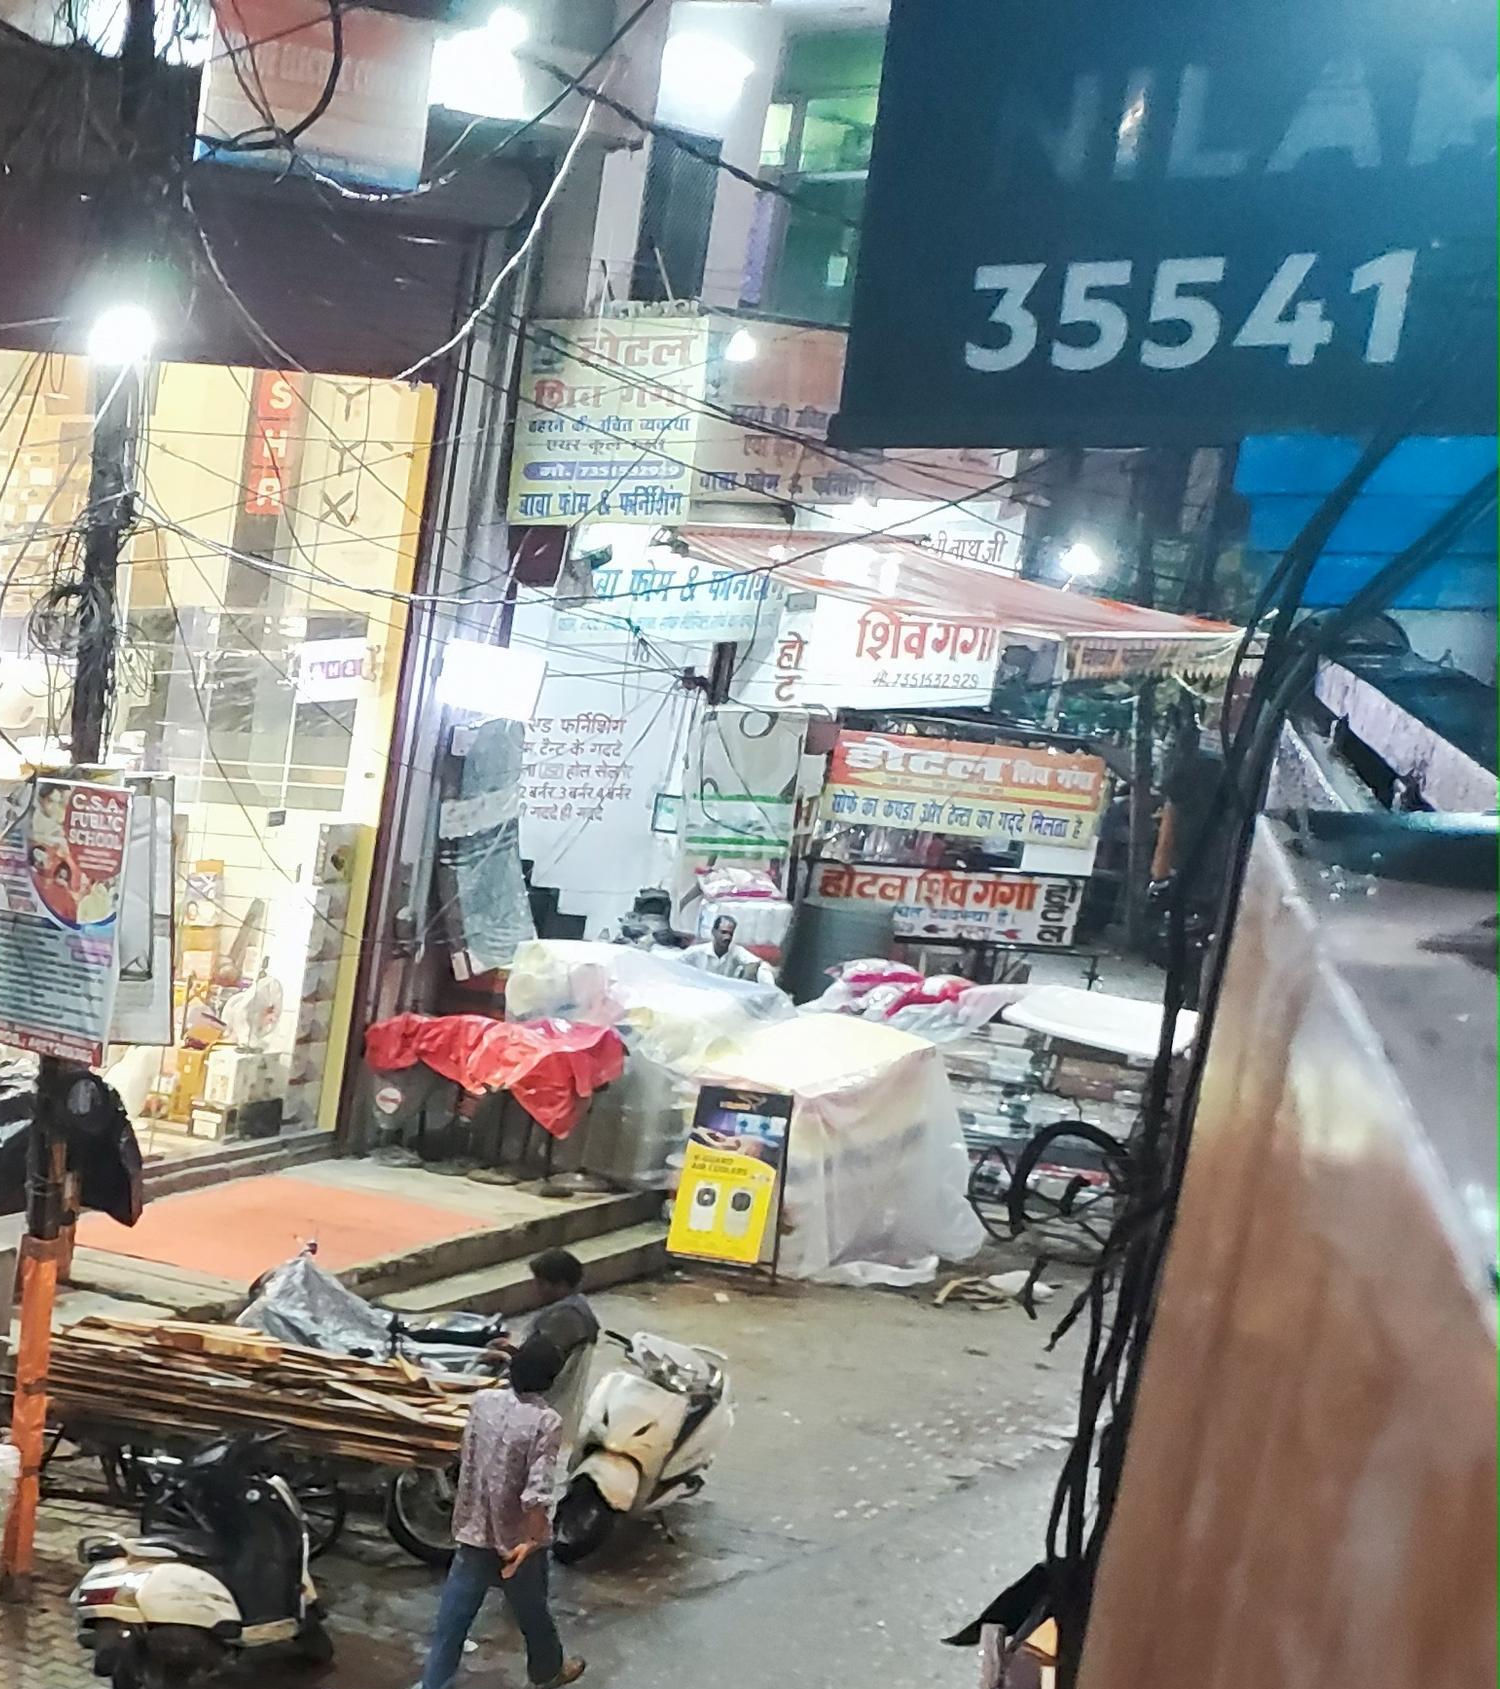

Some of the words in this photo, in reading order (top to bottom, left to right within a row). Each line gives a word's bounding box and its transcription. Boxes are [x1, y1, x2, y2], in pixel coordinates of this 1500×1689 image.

[963, 249, 1419, 373] 35541
[68, 828, 124, 852] SCHOOL
[69, 811, 125, 833] PUBLIC
[818, 859, 909, 900] होटल
[914, 867, 972, 911] शिव
[972, 874, 1042, 911] गंगा
